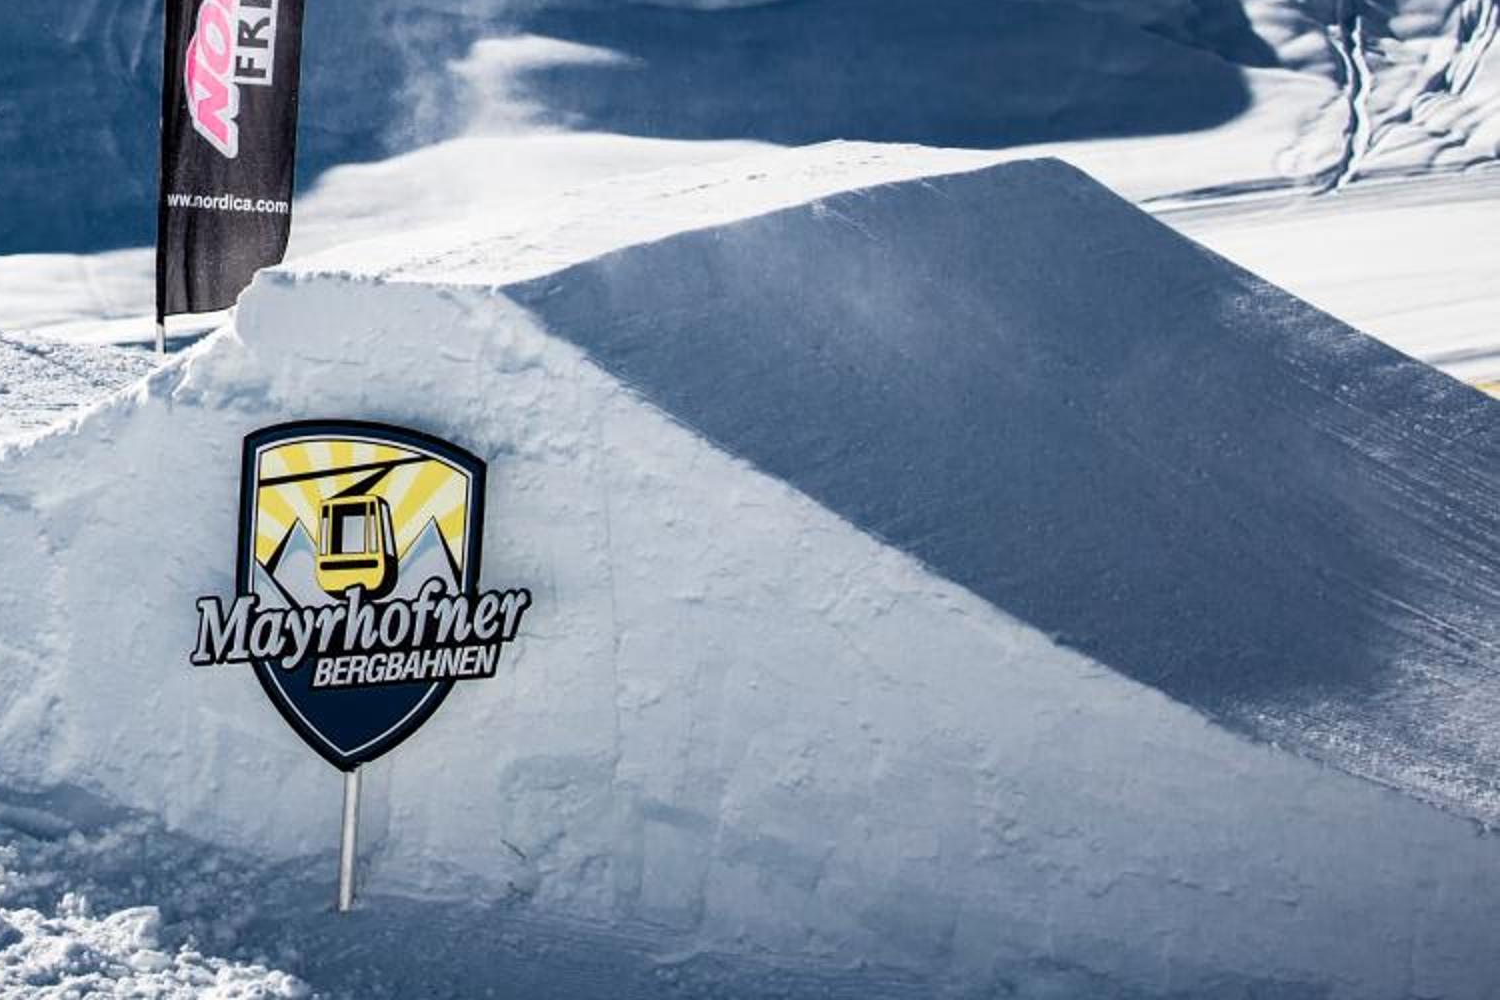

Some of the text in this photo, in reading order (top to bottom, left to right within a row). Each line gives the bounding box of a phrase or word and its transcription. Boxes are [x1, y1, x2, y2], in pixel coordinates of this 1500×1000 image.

[166, 192, 289, 214] ww.nordica.com
[191, 580, 530, 667] Mayrhofner
[313, 645, 497, 686] BERGBAHNEN
